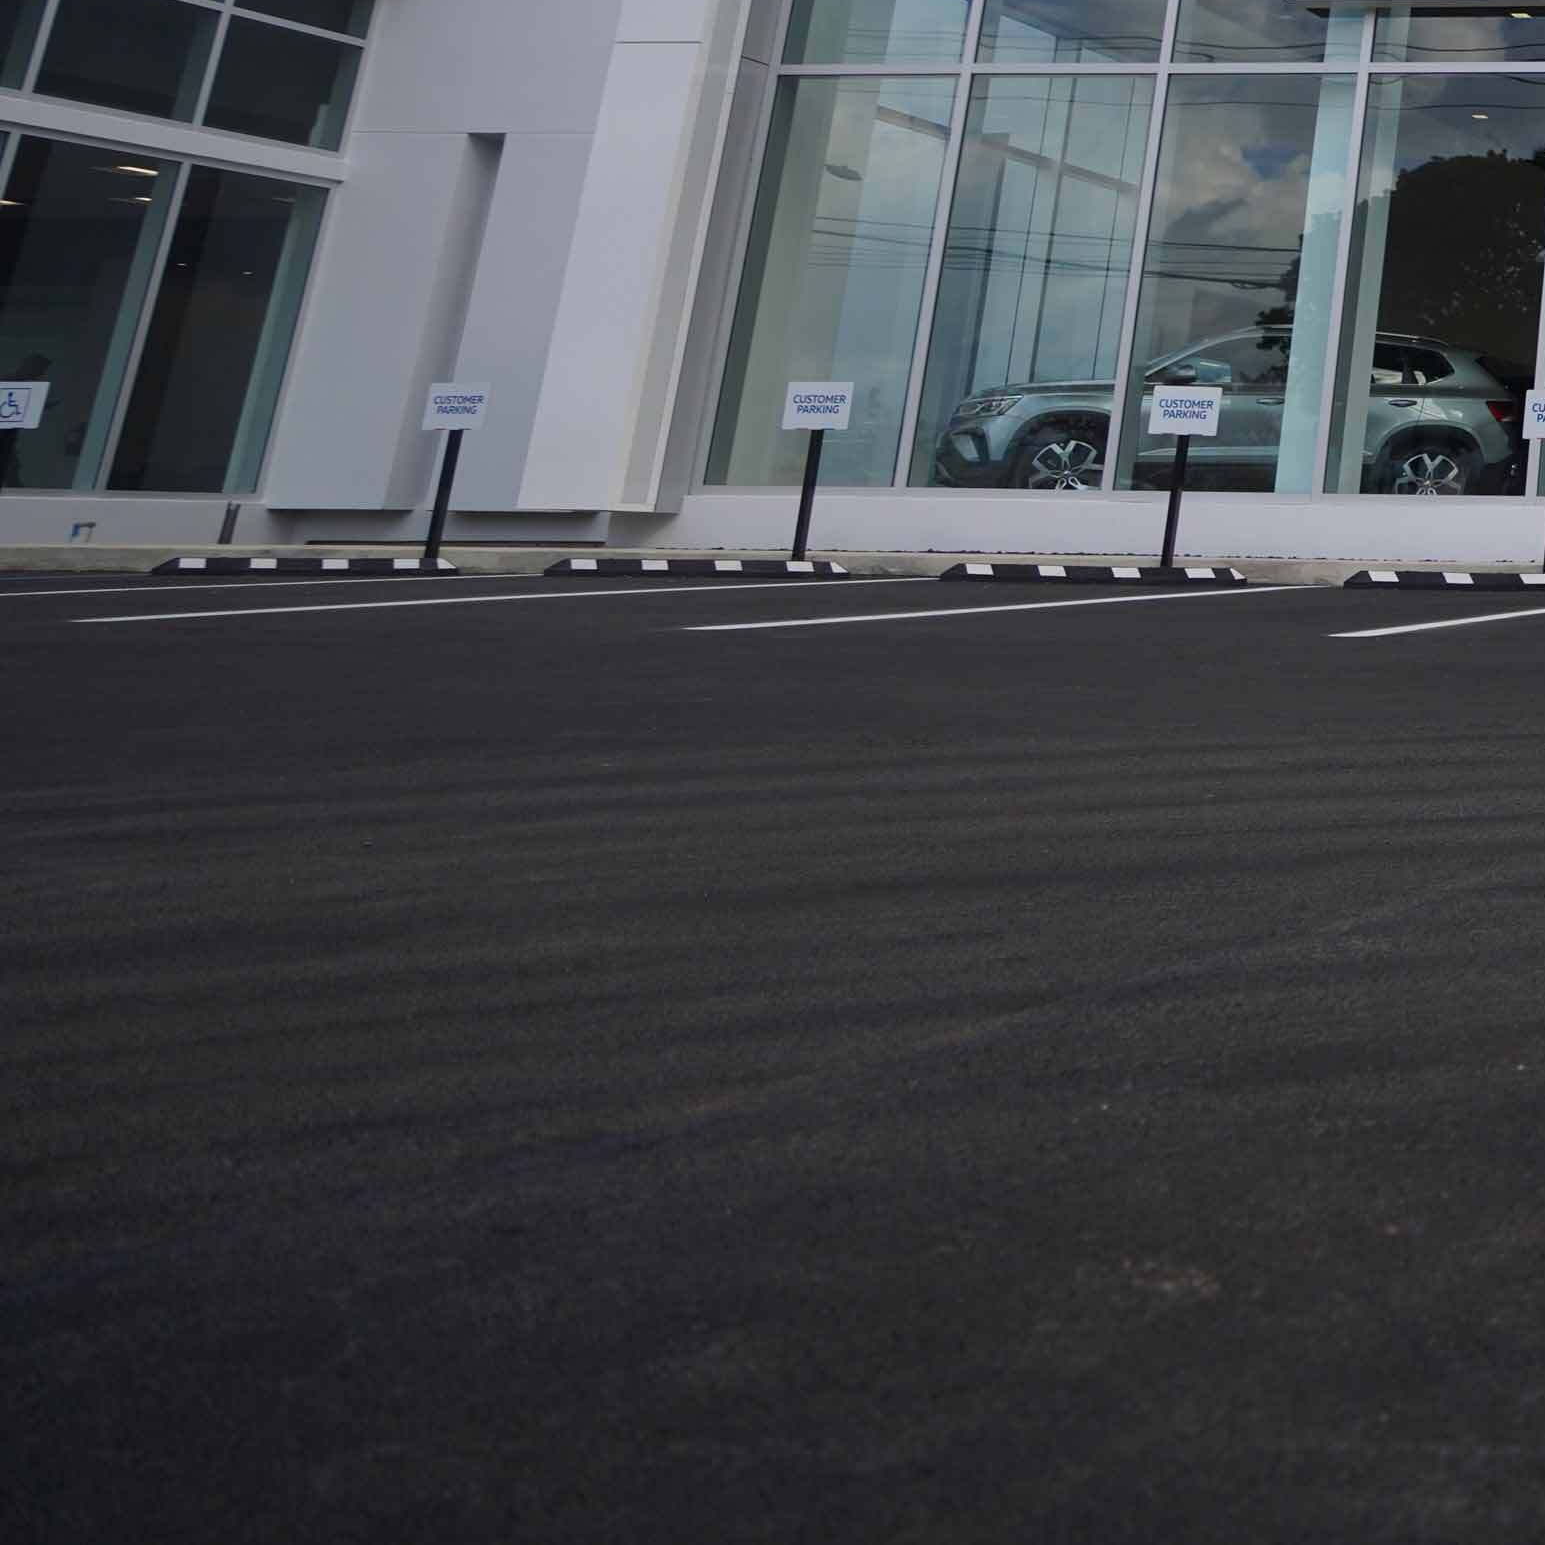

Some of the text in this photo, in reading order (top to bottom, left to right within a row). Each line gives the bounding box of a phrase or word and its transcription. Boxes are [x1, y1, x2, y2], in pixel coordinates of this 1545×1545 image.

[433, 395, 484, 404] CUSTOMER
[793, 394, 847, 404] CUSTOMER
[1160, 399, 1213, 409] CUSTOMER
[437, 405, 478, 414] PARKING
[797, 405, 840, 414] PARKING
[1163, 409, 1207, 420] PARKING
